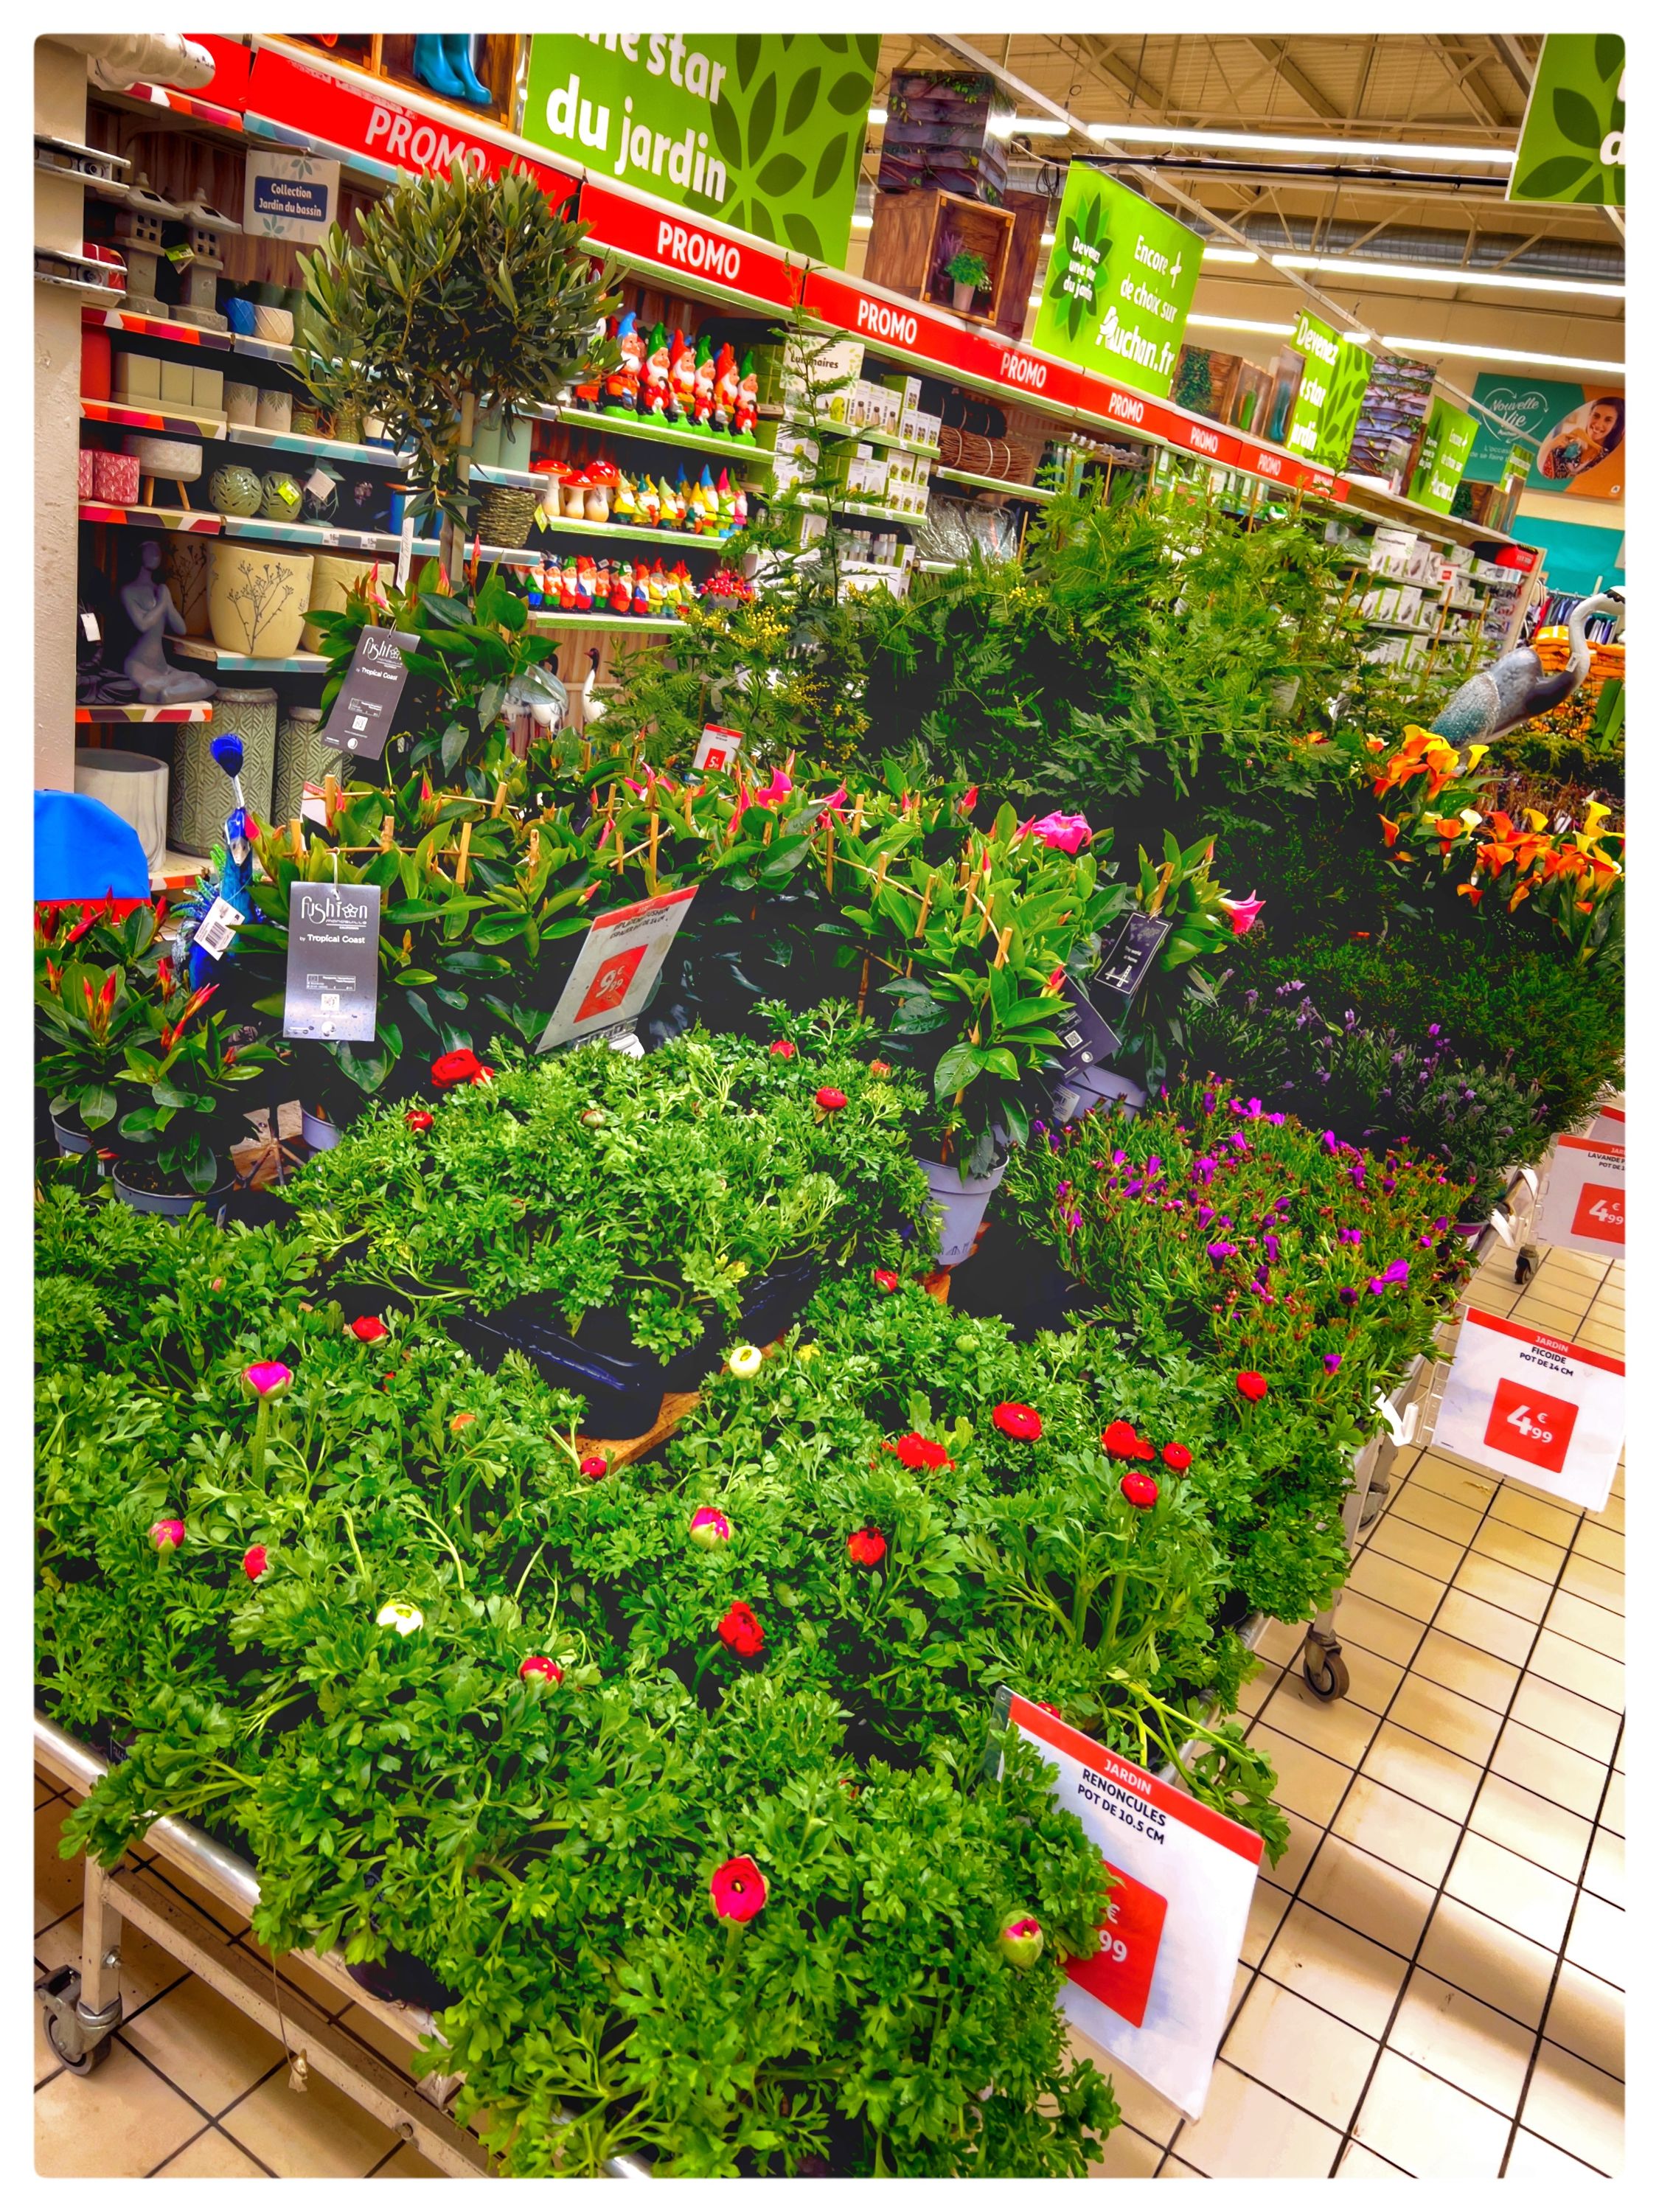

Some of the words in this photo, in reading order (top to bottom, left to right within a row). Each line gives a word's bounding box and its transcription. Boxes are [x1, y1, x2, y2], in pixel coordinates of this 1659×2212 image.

[646, 33, 727, 105] star
[546, 73, 610, 151] du
[614, 96, 726, 203] jardin
[271, 183, 312, 199] Collection
[259, 198, 284, 212] Jardin
[285, 201, 295, 213] du
[296, 203, 321, 216] bassin
[657, 220, 741, 280] PROMO
[1134, 234, 1169, 276] Encore
[1068, 260, 1086, 276] une
[1063, 275, 1074, 293] du
[1120, 273, 1134, 301] de
[1134, 282, 1161, 316] choix
[1161, 301, 1178, 323] sur
[857, 299, 918, 345] PROMO
[1095, 306, 1175, 376] Auchan.fr
[1296, 316, 1339, 366] Devenez
[790, 355, 838, 369] Lunaires
[1000, 351, 1047, 389] PROMO
[1108, 392, 1144, 423] PROMO
[1490, 397, 1539, 411] Nouvelle
[1501, 410, 1527, 428] Vie
[1190, 426, 1218, 453] PROMO
[1256, 453, 1281, 476] PROMO
[361, 667, 382, 678] Tropical
[383, 672, 398, 681] Coast
[307, 933, 339, 943] Tropical
[342, 935, 365, 944] Coast
[1587, 1152, 1620, 1163] LAVANDE
[1531, 1346, 1567, 1364] FICOIDE
[1535, 1335, 1569, 1353] JARDIN
[1520, 1352, 1537, 1363] POT
[1537, 1359, 1548, 1368] DE
[1549, 1363, 1559, 1371] 14
[1561, 1368, 1573, 1377] CM
[1104, 1759, 1152, 1795] JARDIN
[1082, 1768, 1166, 1826] RENONCULES
[1078, 1784, 1101, 1805] POT
[1102, 1798, 1118, 1817] DE
[1119, 1809, 1144, 1832] 10.5
[1146, 1826, 1165, 1845] CM
